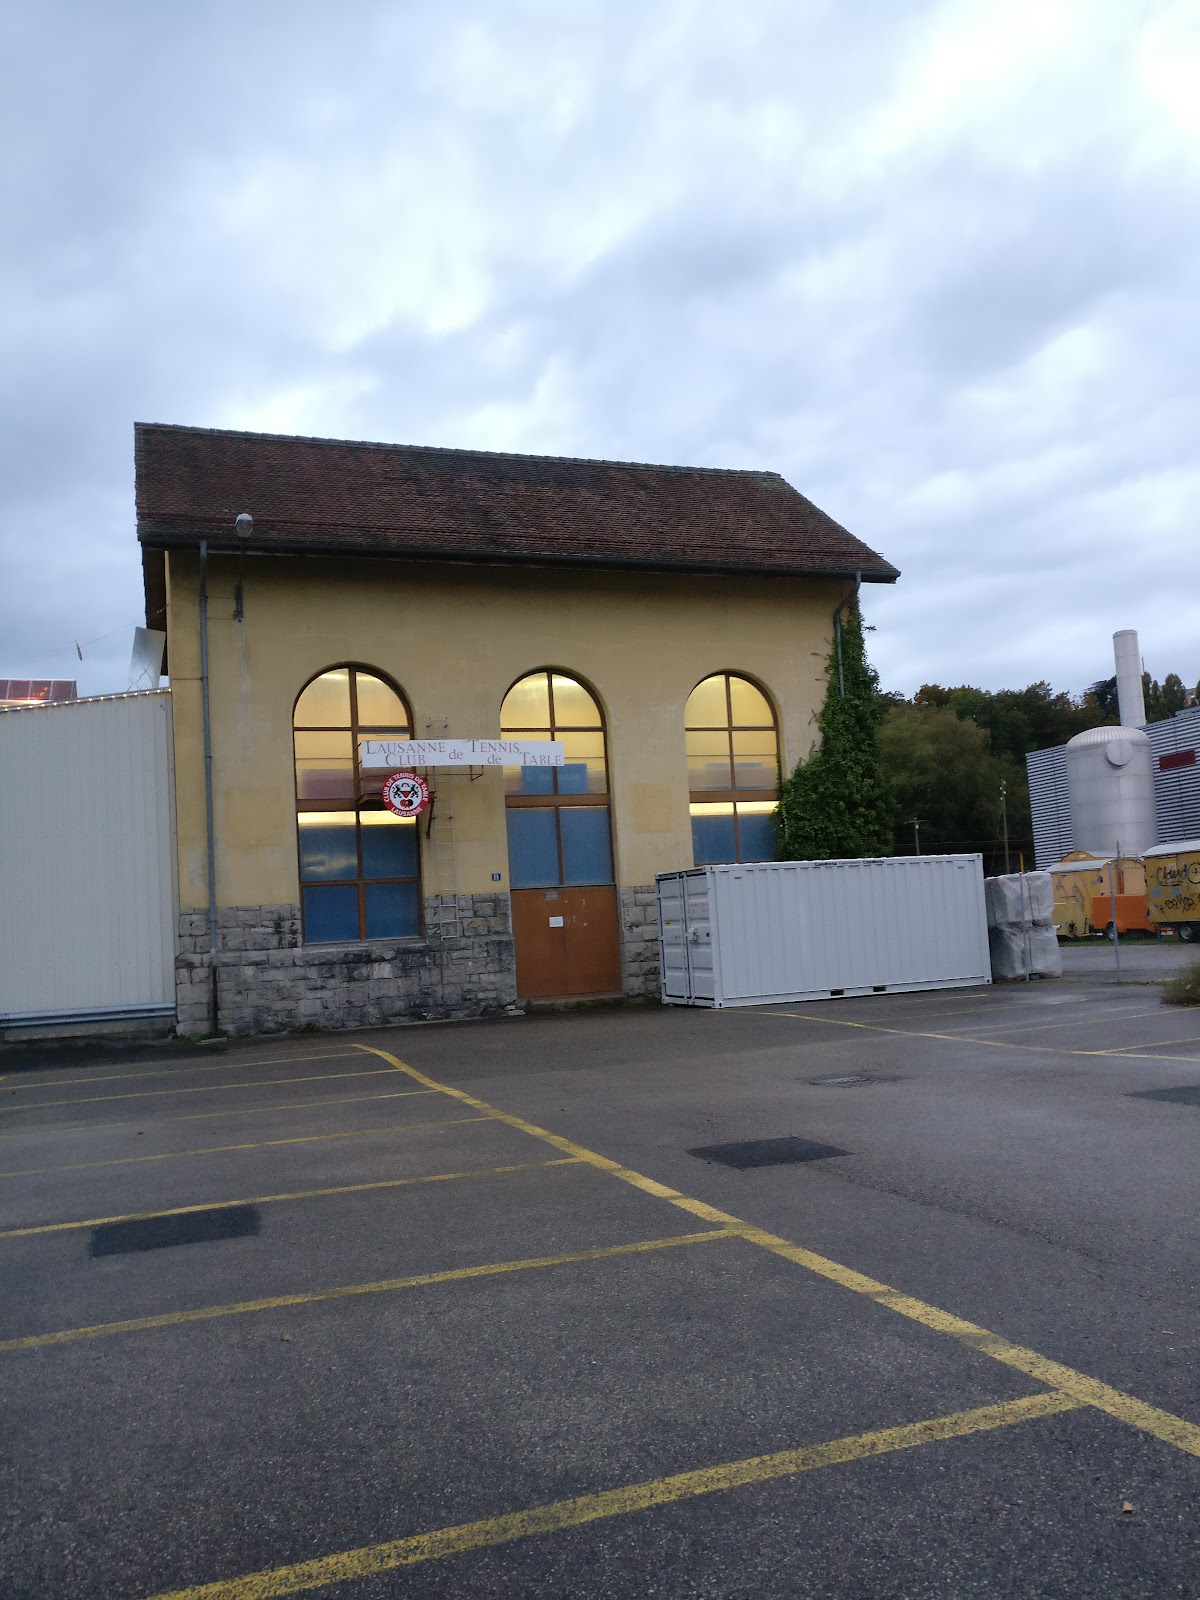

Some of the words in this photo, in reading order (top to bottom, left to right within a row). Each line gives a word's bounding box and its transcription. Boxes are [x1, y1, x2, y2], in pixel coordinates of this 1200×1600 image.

[366, 740, 446, 755] LAUSANNE
[467, 739, 520, 754] TENNIS
[385, 753, 426, 767] CLUB
[449, 749, 463, 760] de
[487, 754, 502, 765] de
[519, 752, 561, 766] TABLE
[392, 772, 415, 780] TENNIS
[414, 776, 423, 784] DE
[391, 806, 423, 817] LAUSANNE
